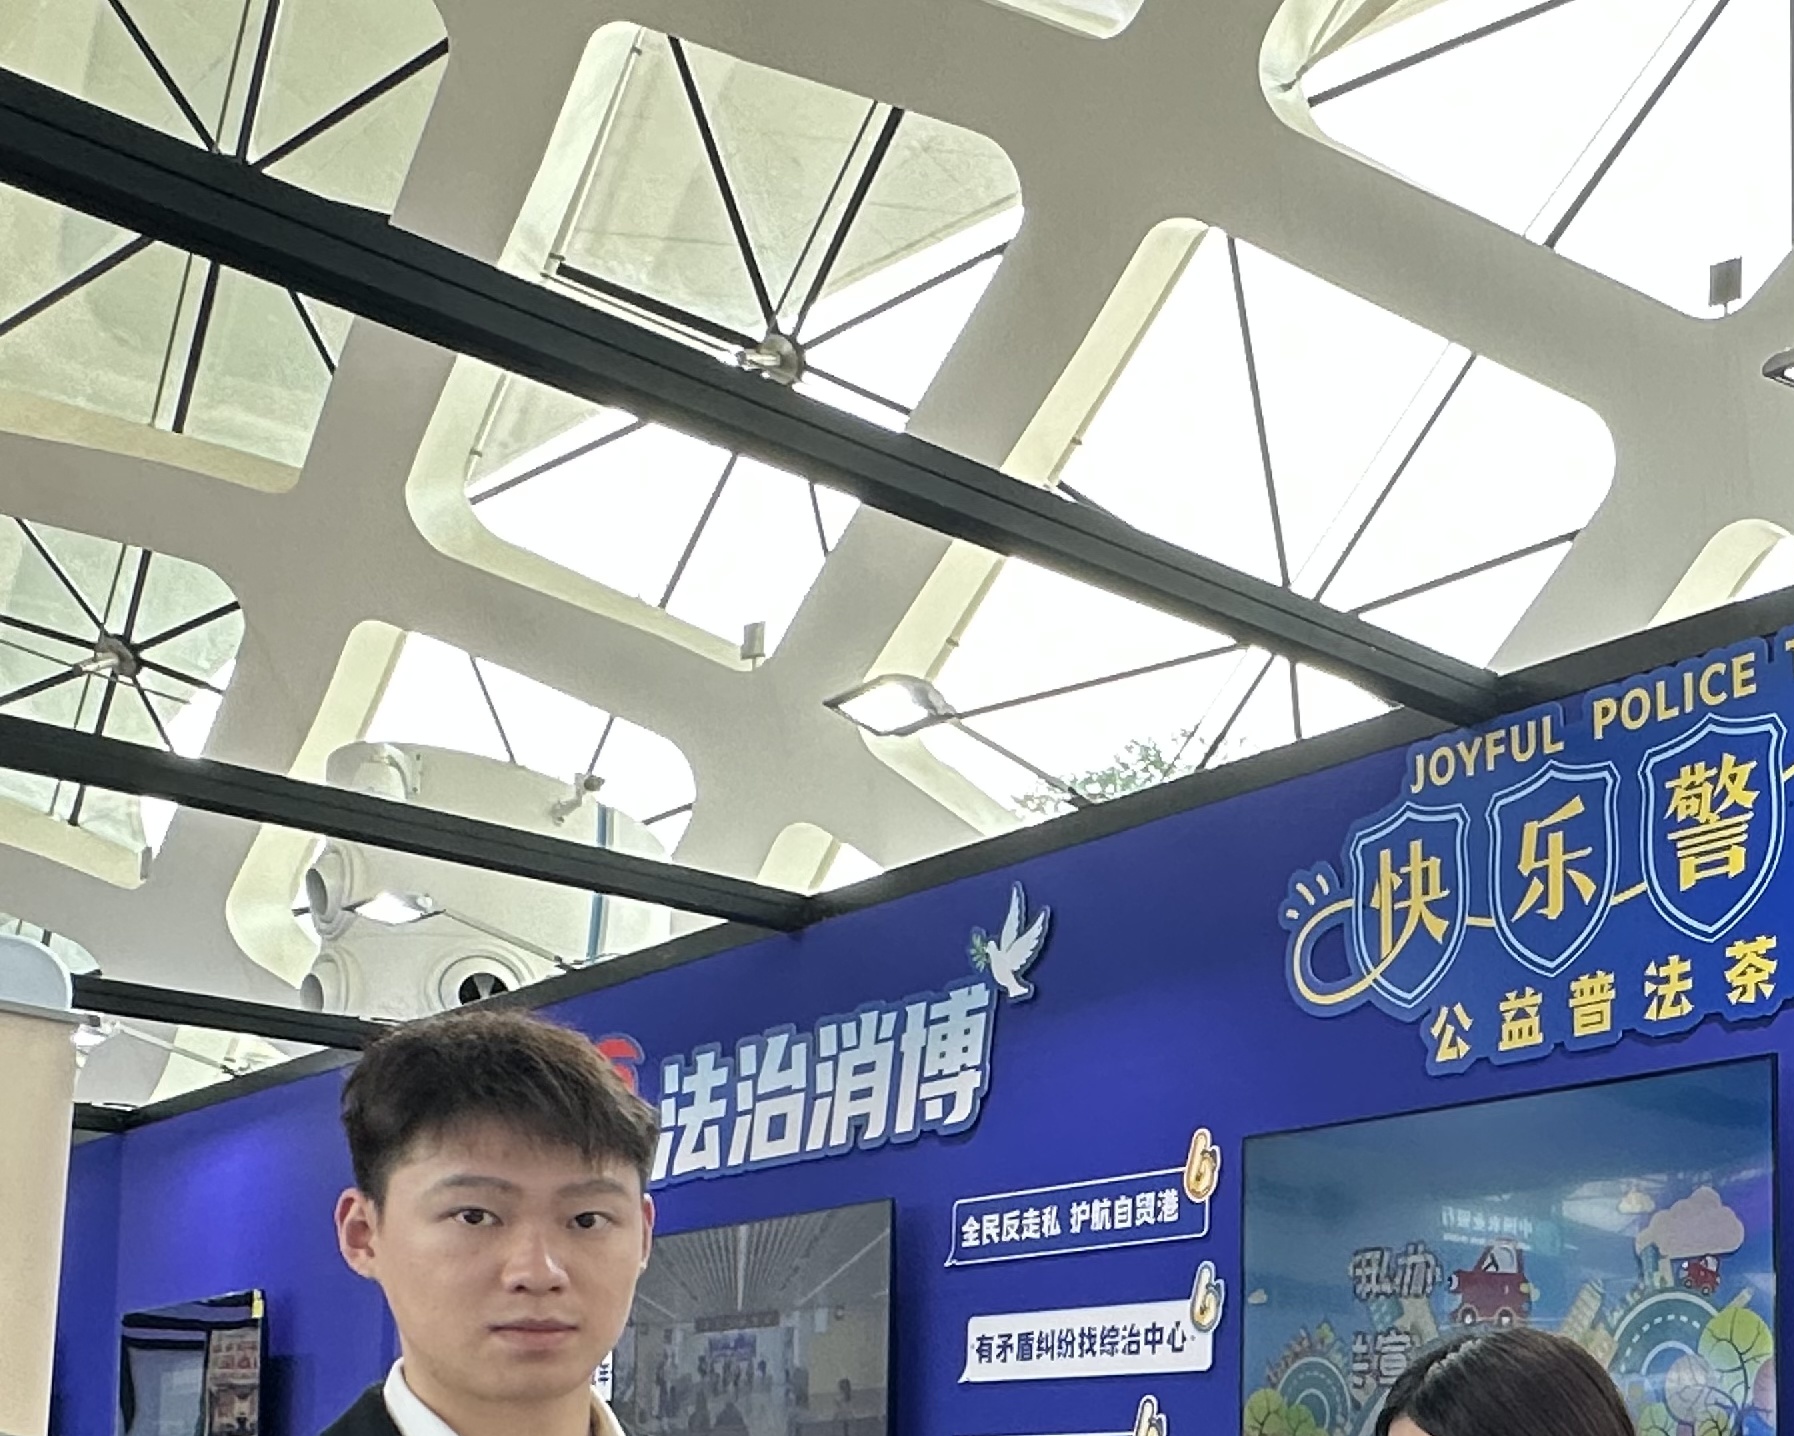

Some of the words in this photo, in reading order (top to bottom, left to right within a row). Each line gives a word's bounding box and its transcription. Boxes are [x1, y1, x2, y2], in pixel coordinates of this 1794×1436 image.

[1411, 722, 1565, 793] JOYFUL
[1594, 653, 1758, 741] POLICE
[653, 982, 990, 1182] 法治消博
[960, 1204, 1061, 1248] 全民反走私
[1069, 1189, 1180, 1234] 护航自贸港
[974, 1319, 1188, 1365] 有矛盾纠纷找综治中心
